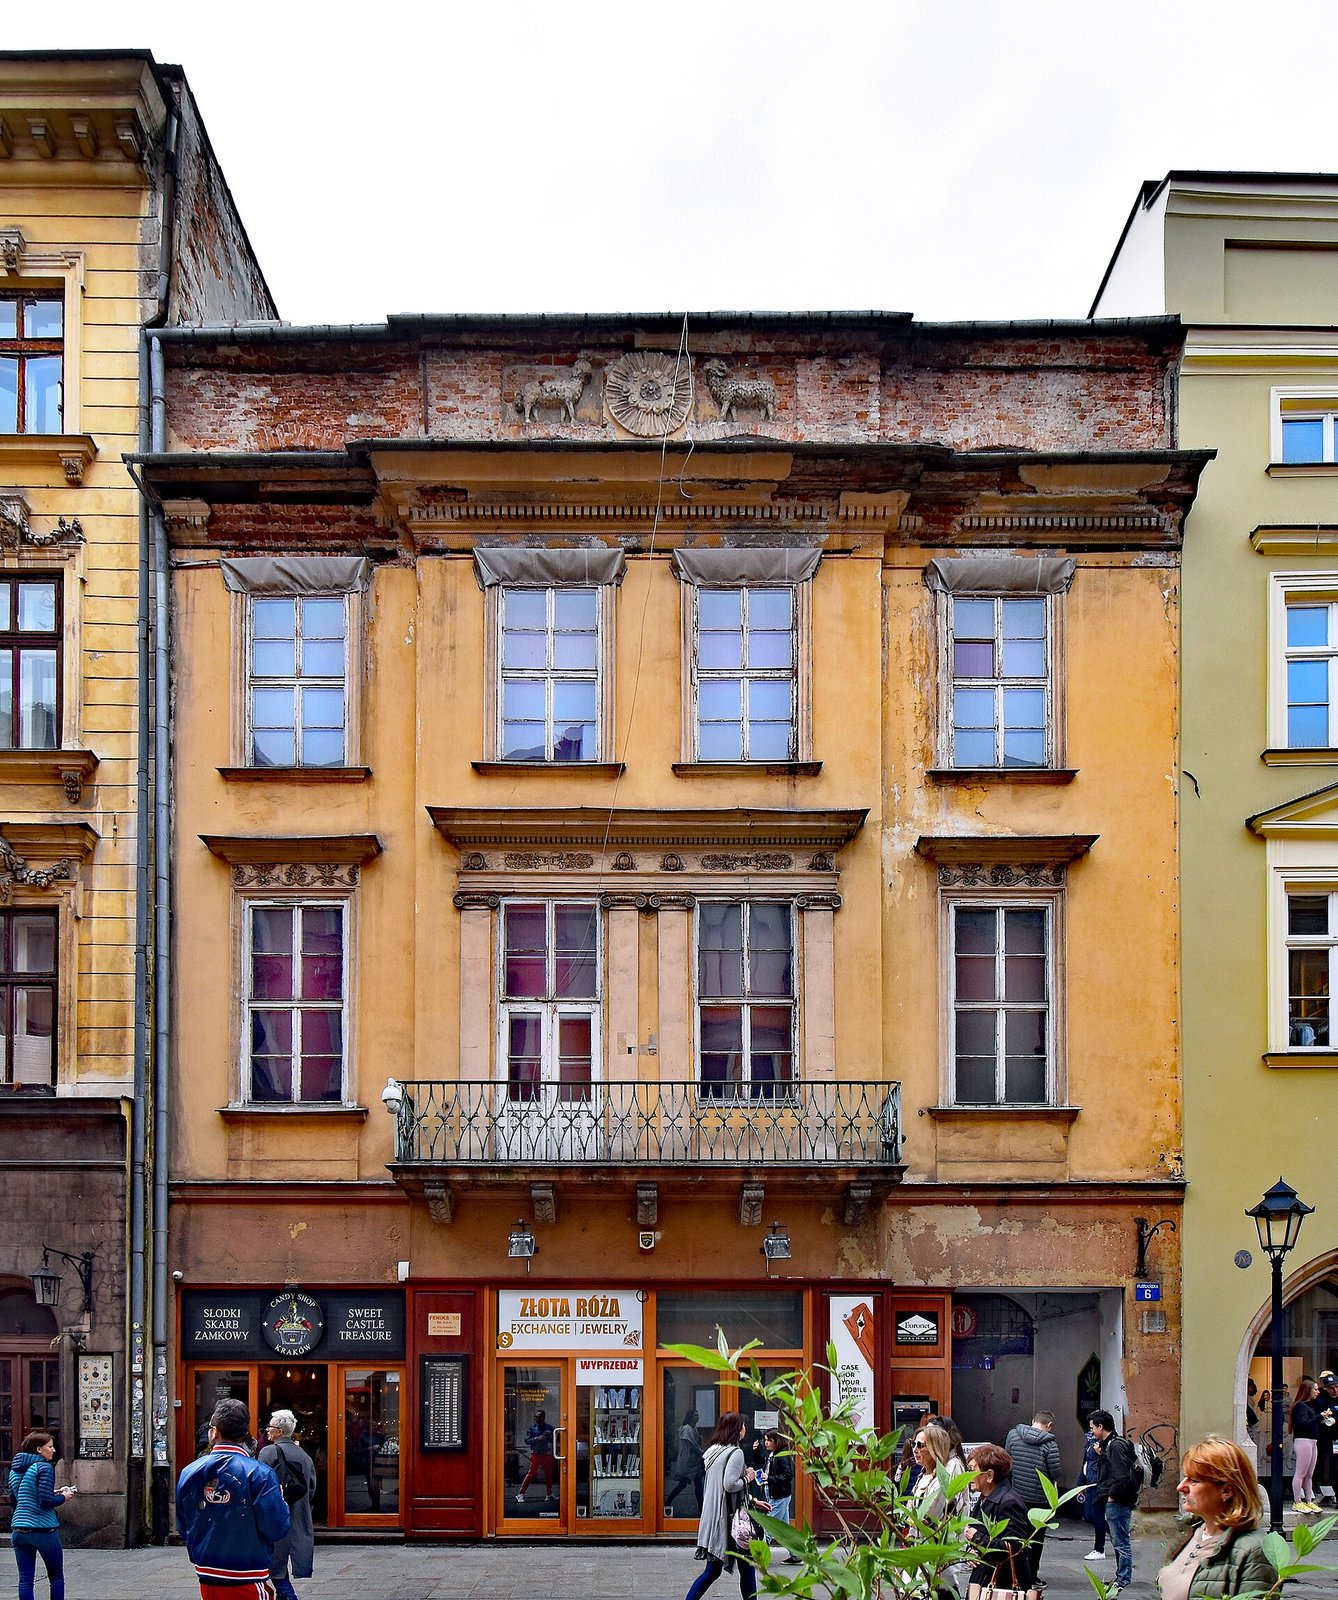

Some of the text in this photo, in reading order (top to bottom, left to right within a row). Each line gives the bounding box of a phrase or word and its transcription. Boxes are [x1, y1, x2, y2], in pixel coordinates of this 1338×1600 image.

[1144, 1289, 1152, 1299] 6
[270, 1293, 316, 1309] CANDY SHOP
[519, 1294, 621, 1317] ZŁOTA RÓŻA
[203, 1308, 241, 1318] SŁODKI
[348, 1308, 383, 1318] SWEET
[205, 1319, 239, 1329] SKARB
[345, 1319, 385, 1329] CASTLE
[510, 1323, 629, 1335] EXCHANGE JEWELRY
[904, 1321, 931, 1329] Euronet
[194, 1330, 250, 1341] ZAMKOWY
[338, 1330, 392, 1341] TREASURE
[274, 1342, 312, 1356] KRAKÓW
[580, 1358, 639, 1370] WYPRZEDAŻ
